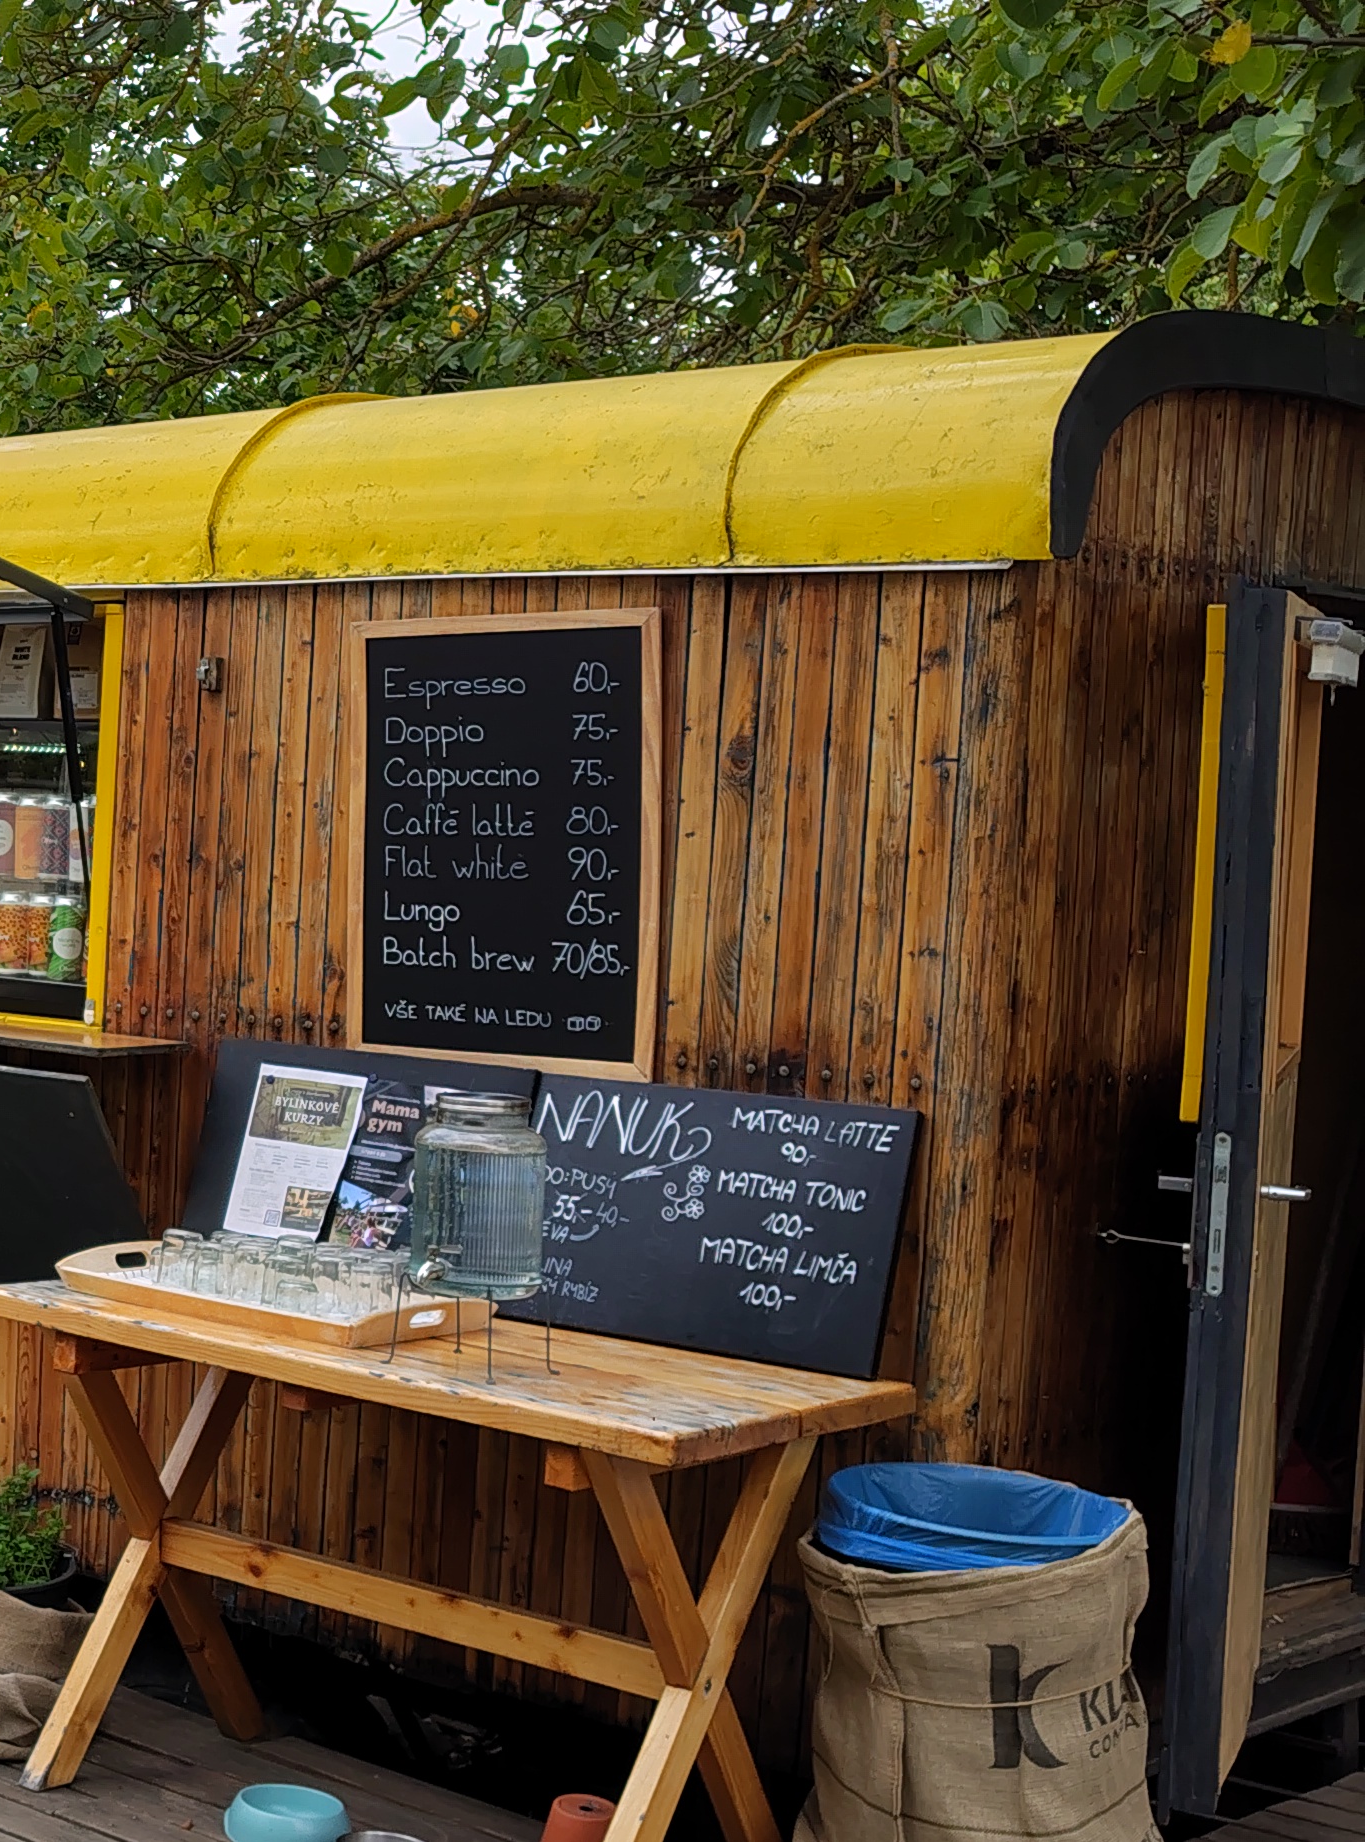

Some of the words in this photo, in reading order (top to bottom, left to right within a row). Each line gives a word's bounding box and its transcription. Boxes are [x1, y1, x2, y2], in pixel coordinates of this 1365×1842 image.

[384, 668, 526, 709] Espresso
[573, 662, 620, 694] 60,-
[385, 715, 484, 758] Doppio
[572, 713, 618, 740] 75,-
[384, 757, 540, 799] Cappuccino
[570, 759, 615, 785] 75,-
[566, 806, 619, 835] 80,-
[385, 845, 437, 878] Flat
[568, 846, 619, 881] 90,-
[384, 890, 460, 931] Lungo
[567, 890, 621, 925] 65,-
[383, 936, 457, 969] Batch
[471, 935, 535, 972] brew
[384, 1000, 418, 1019] VŠE
[425, 1003, 467, 1022] TAKÉ
[475, 1007, 499, 1024] NA
[505, 1009, 552, 1028] LEDU
[275, 1095, 340, 1114] BYLINKOVÉ
[283, 1111, 325, 1126] KURZY
[372, 1099, 420, 1120] Mama
[367, 1117, 403, 1134] gym
[536, 1090, 695, 1162] NANUK
[731, 1107, 820, 1136] MATCHA
[824, 1120, 901, 1152] LATTE
[716, 1169, 797, 1204] MATCHA
[805, 1181, 867, 1213] TONIC
[541, 1219, 570, 1244] EVA
[761, 1212, 815, 1240] 100,-
[541, 1256, 573, 1277] INA
[698, 1236, 789, 1275] MATCHA
[792, 1250, 858, 1285] LIMČA
[560, 1280, 599, 1303] RYBÍZ
[739, 1281, 797, 1312] 100,-
